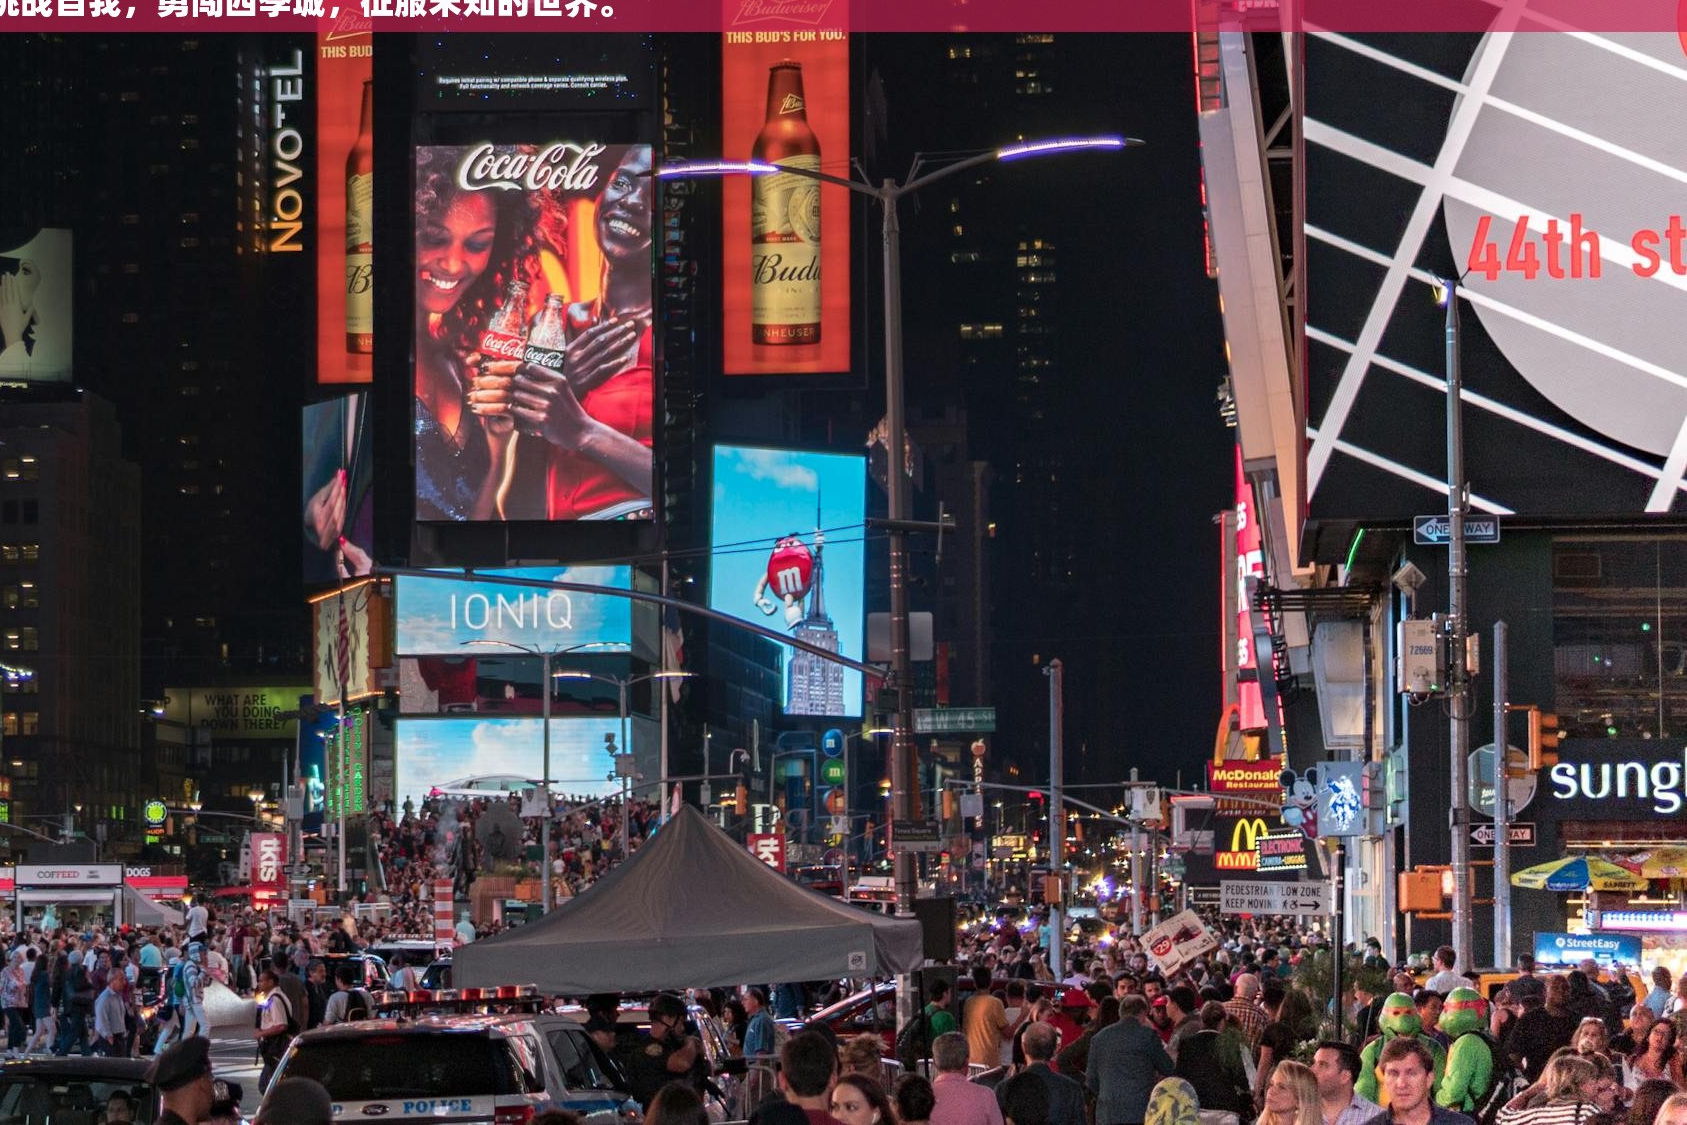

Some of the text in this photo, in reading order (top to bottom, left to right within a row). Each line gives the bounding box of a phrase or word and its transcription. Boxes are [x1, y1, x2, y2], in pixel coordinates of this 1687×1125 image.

[726, 28, 846, 44] THIS BUD'S FOR YOU.
[321, 45, 347, 59] THIS
[271, 49, 303, 253] NOVOTEL
[459, 141, 606, 193] Coca-Cola
[1469, 213, 1602, 281] 44th
[482, 333, 565, 369] Coca-Cola Coca-Cola
[1426, 521, 1490, 536] ONE WAY
[450, 592, 574, 630] IONIQ
[204, 694, 267, 706] WHAT ARE
[214, 706, 282, 718] YOU DOING
[201, 718, 288, 731] DOWN THERE?
[936, 711, 949, 730] W
[957, 712, 976, 730] 45
[1226, 781, 1280, 789] Restaurant
[1260, 837, 1305, 854] ELECTRONIC
[260, 837, 282, 883] tkts
[37, 870, 80, 880] COFFEED
[126, 867, 152, 878] DOGS
[1300, 887, 1321, 898] ZONE
[1225, 898, 1246, 909] KEEP
[1566, 938, 1620, 950] StreetEasy
[402, 1098, 472, 1115] POLICE
